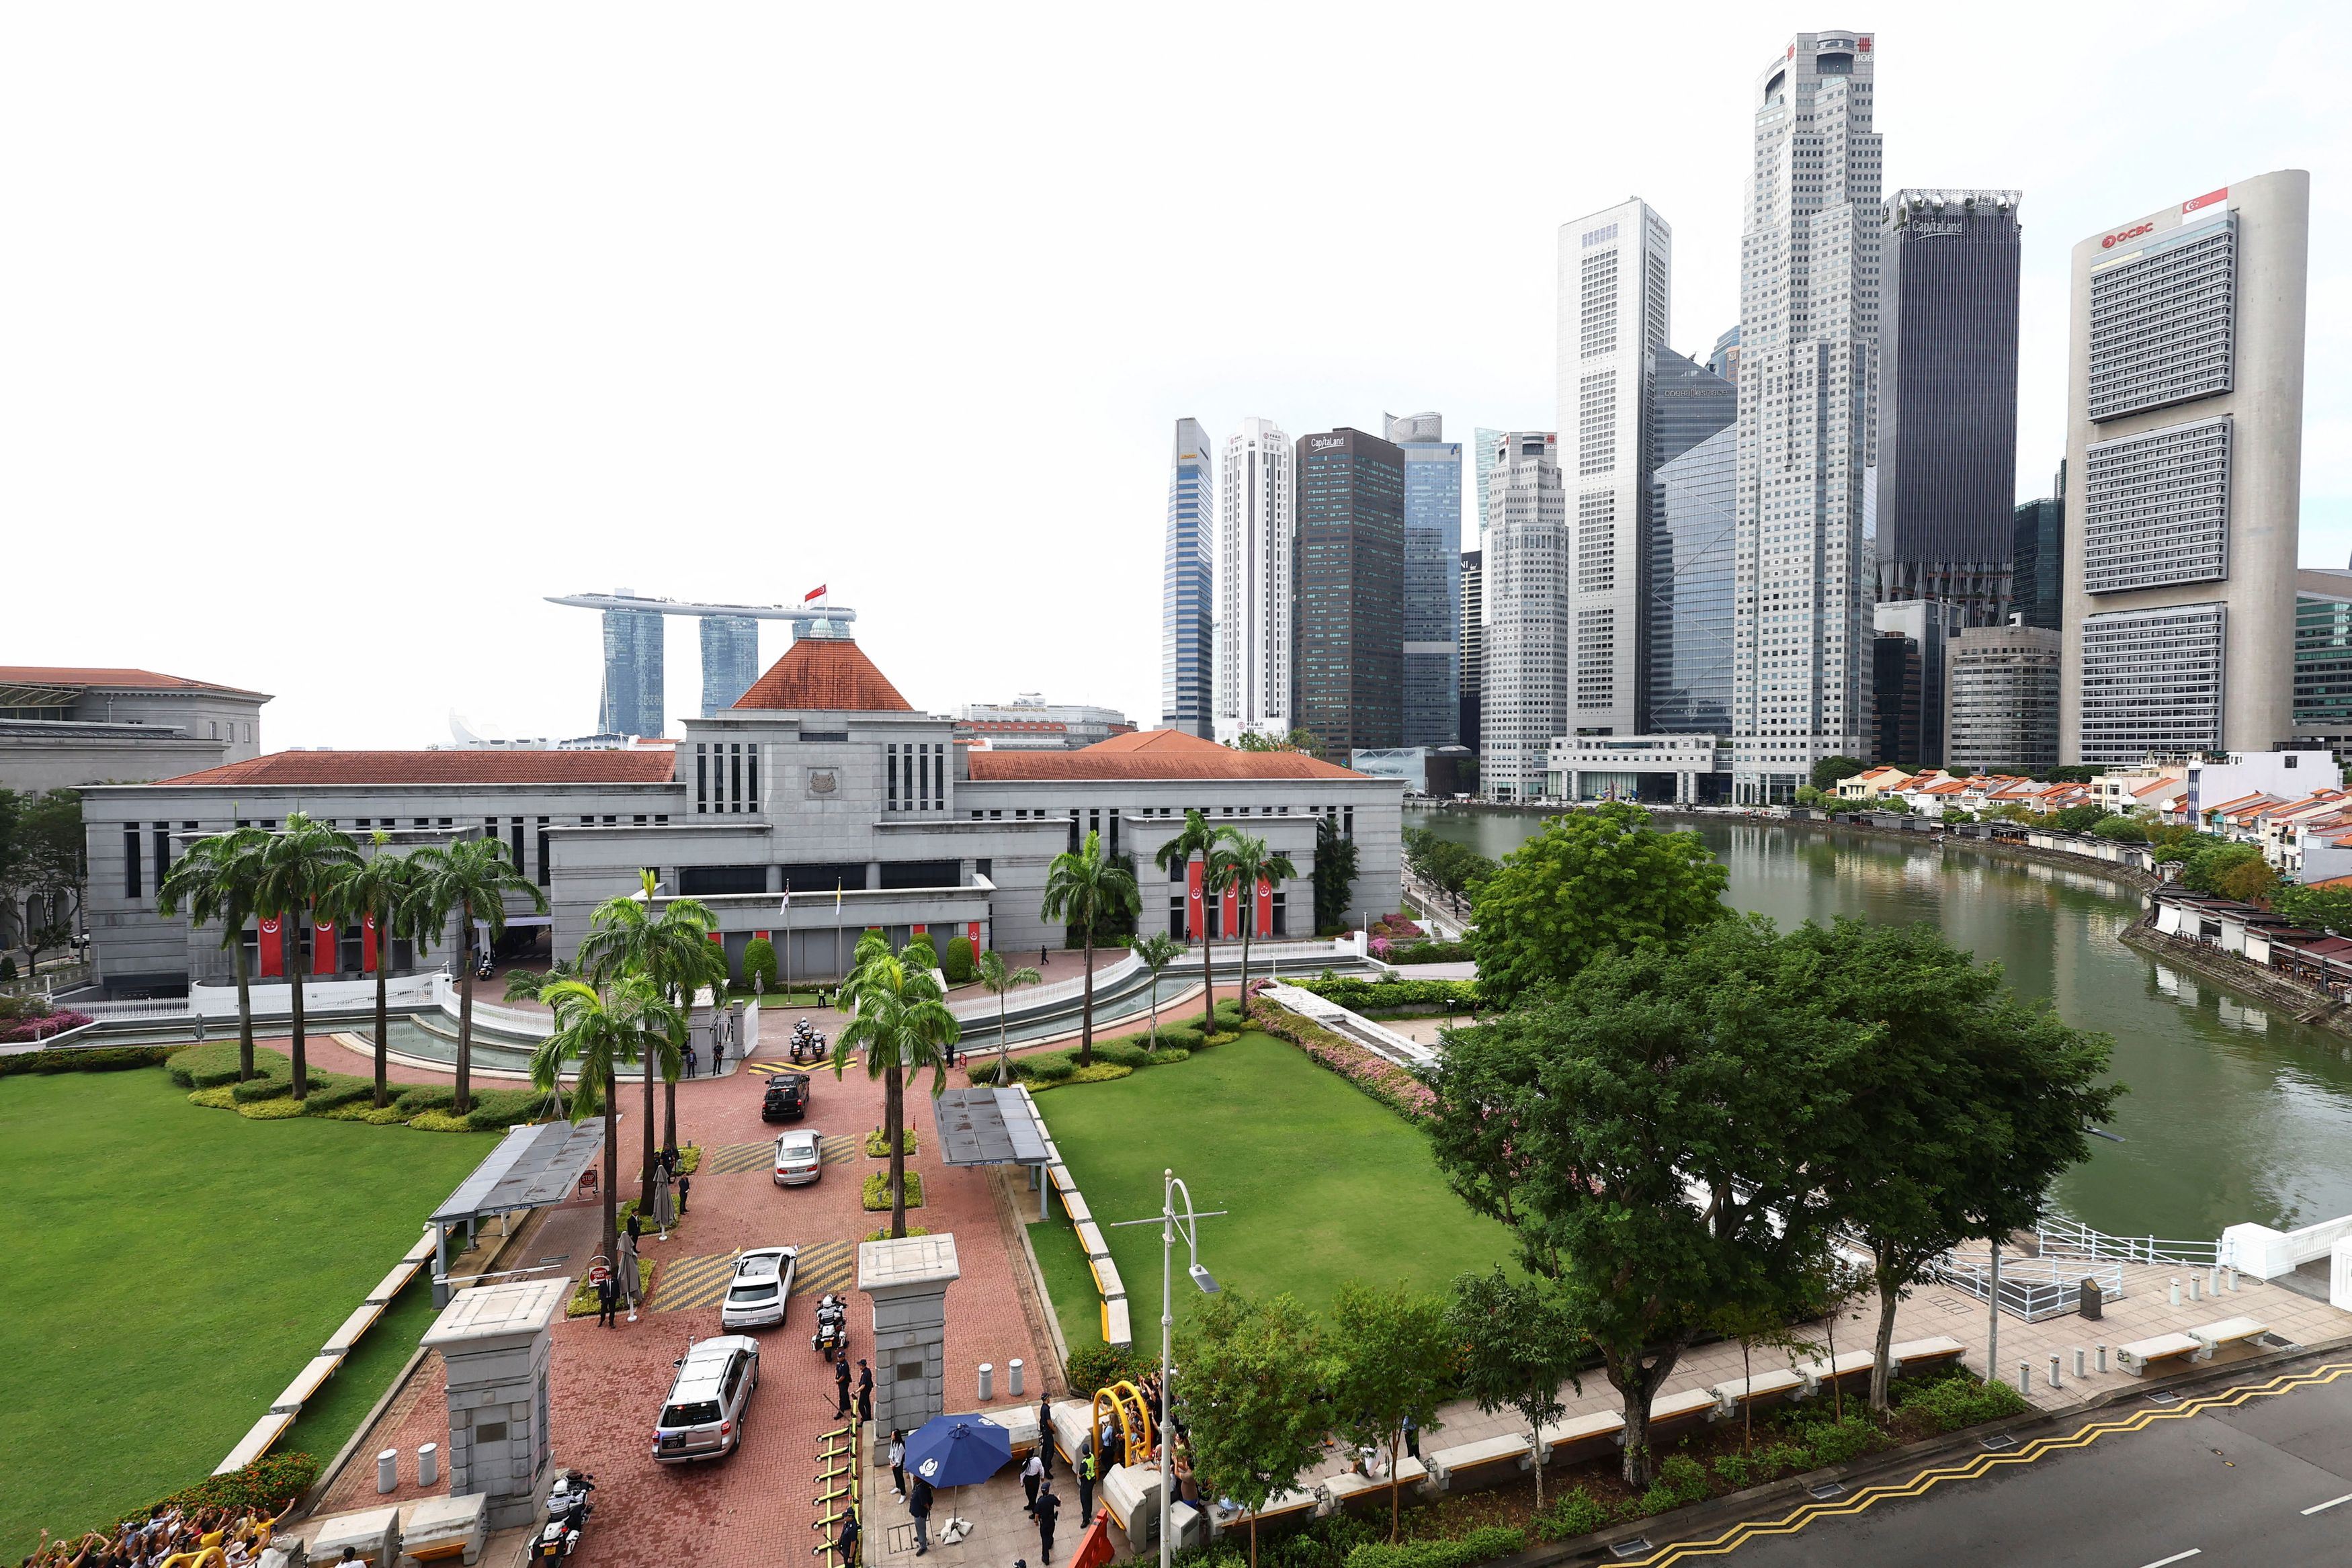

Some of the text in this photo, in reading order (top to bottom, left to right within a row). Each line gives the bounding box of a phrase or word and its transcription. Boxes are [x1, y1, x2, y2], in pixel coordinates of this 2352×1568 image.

[1855, 54, 1873, 62] UOB
[1913, 218, 1962, 235] CapitaLand
[2117, 222, 2153, 242] OCBC
[1311, 437, 1344, 448] CapitaLand
